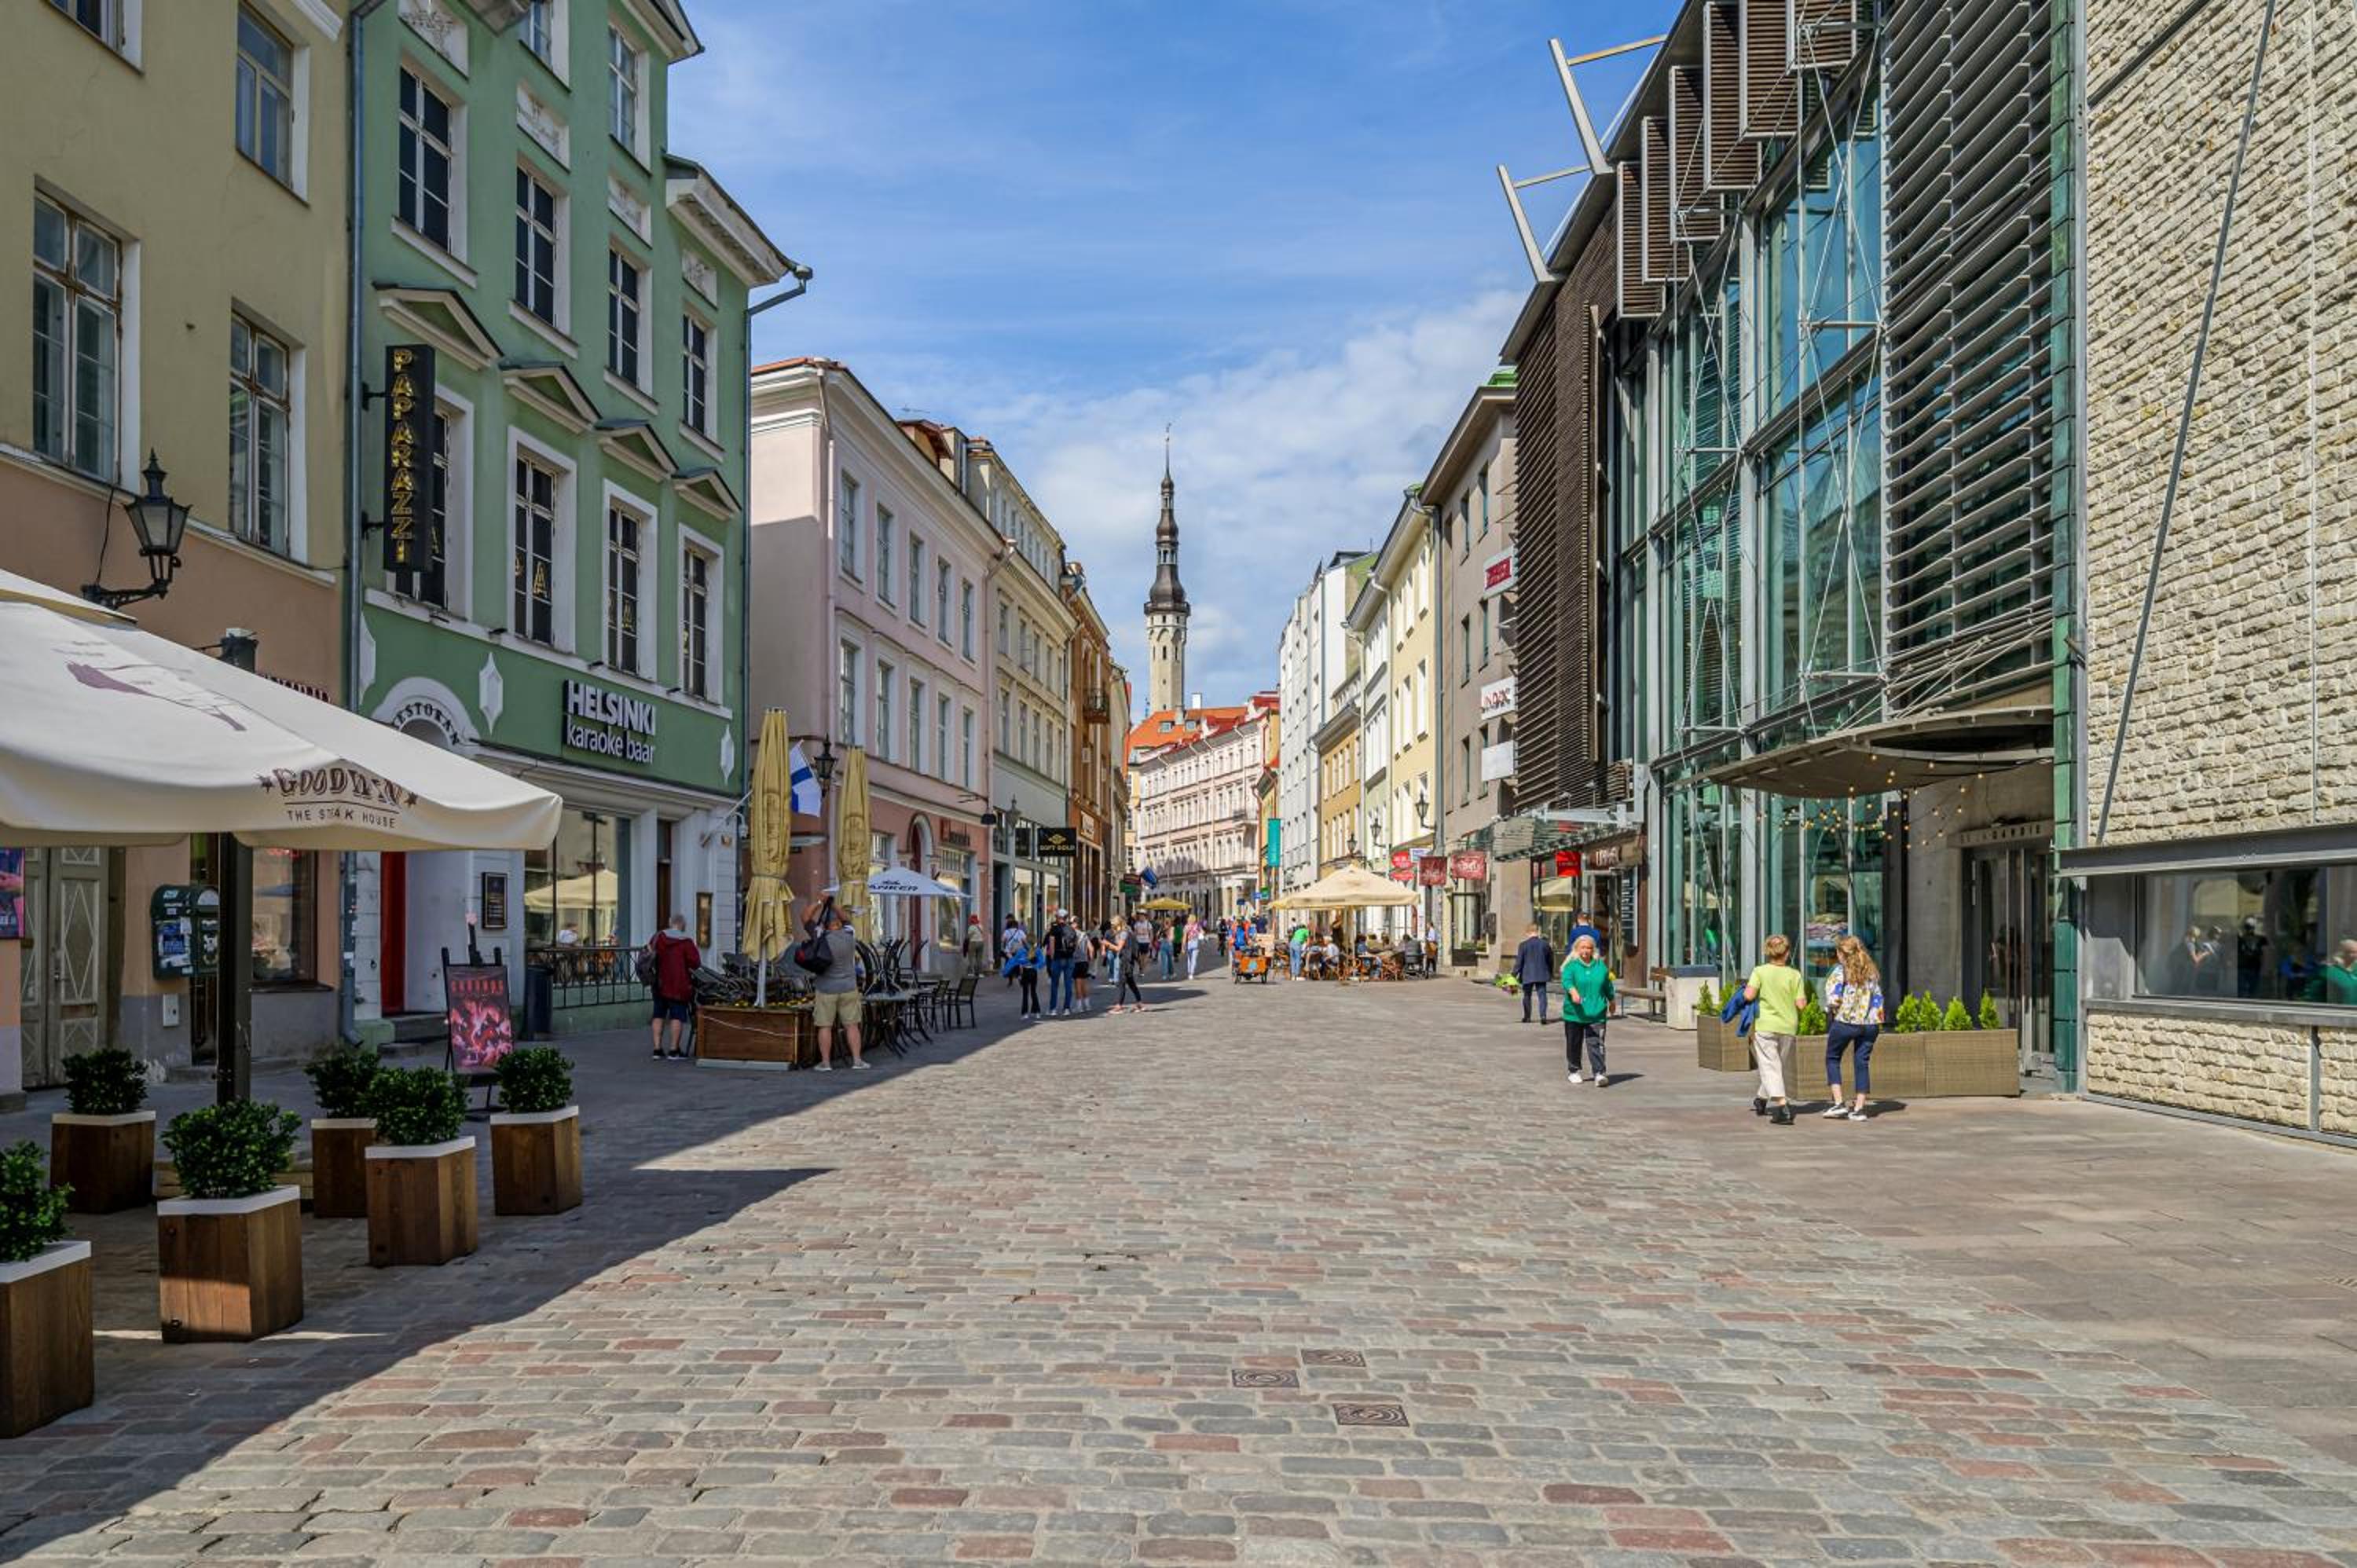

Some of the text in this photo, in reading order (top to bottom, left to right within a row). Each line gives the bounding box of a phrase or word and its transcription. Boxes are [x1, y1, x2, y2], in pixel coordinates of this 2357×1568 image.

[391, 348, 415, 563] PAPARAZZI
[567, 678, 656, 737] HELSINKI
[566, 714, 656, 764] karaoke baar
[286, 809, 312, 822] THE
[362, 811, 397, 828] HOUSE
